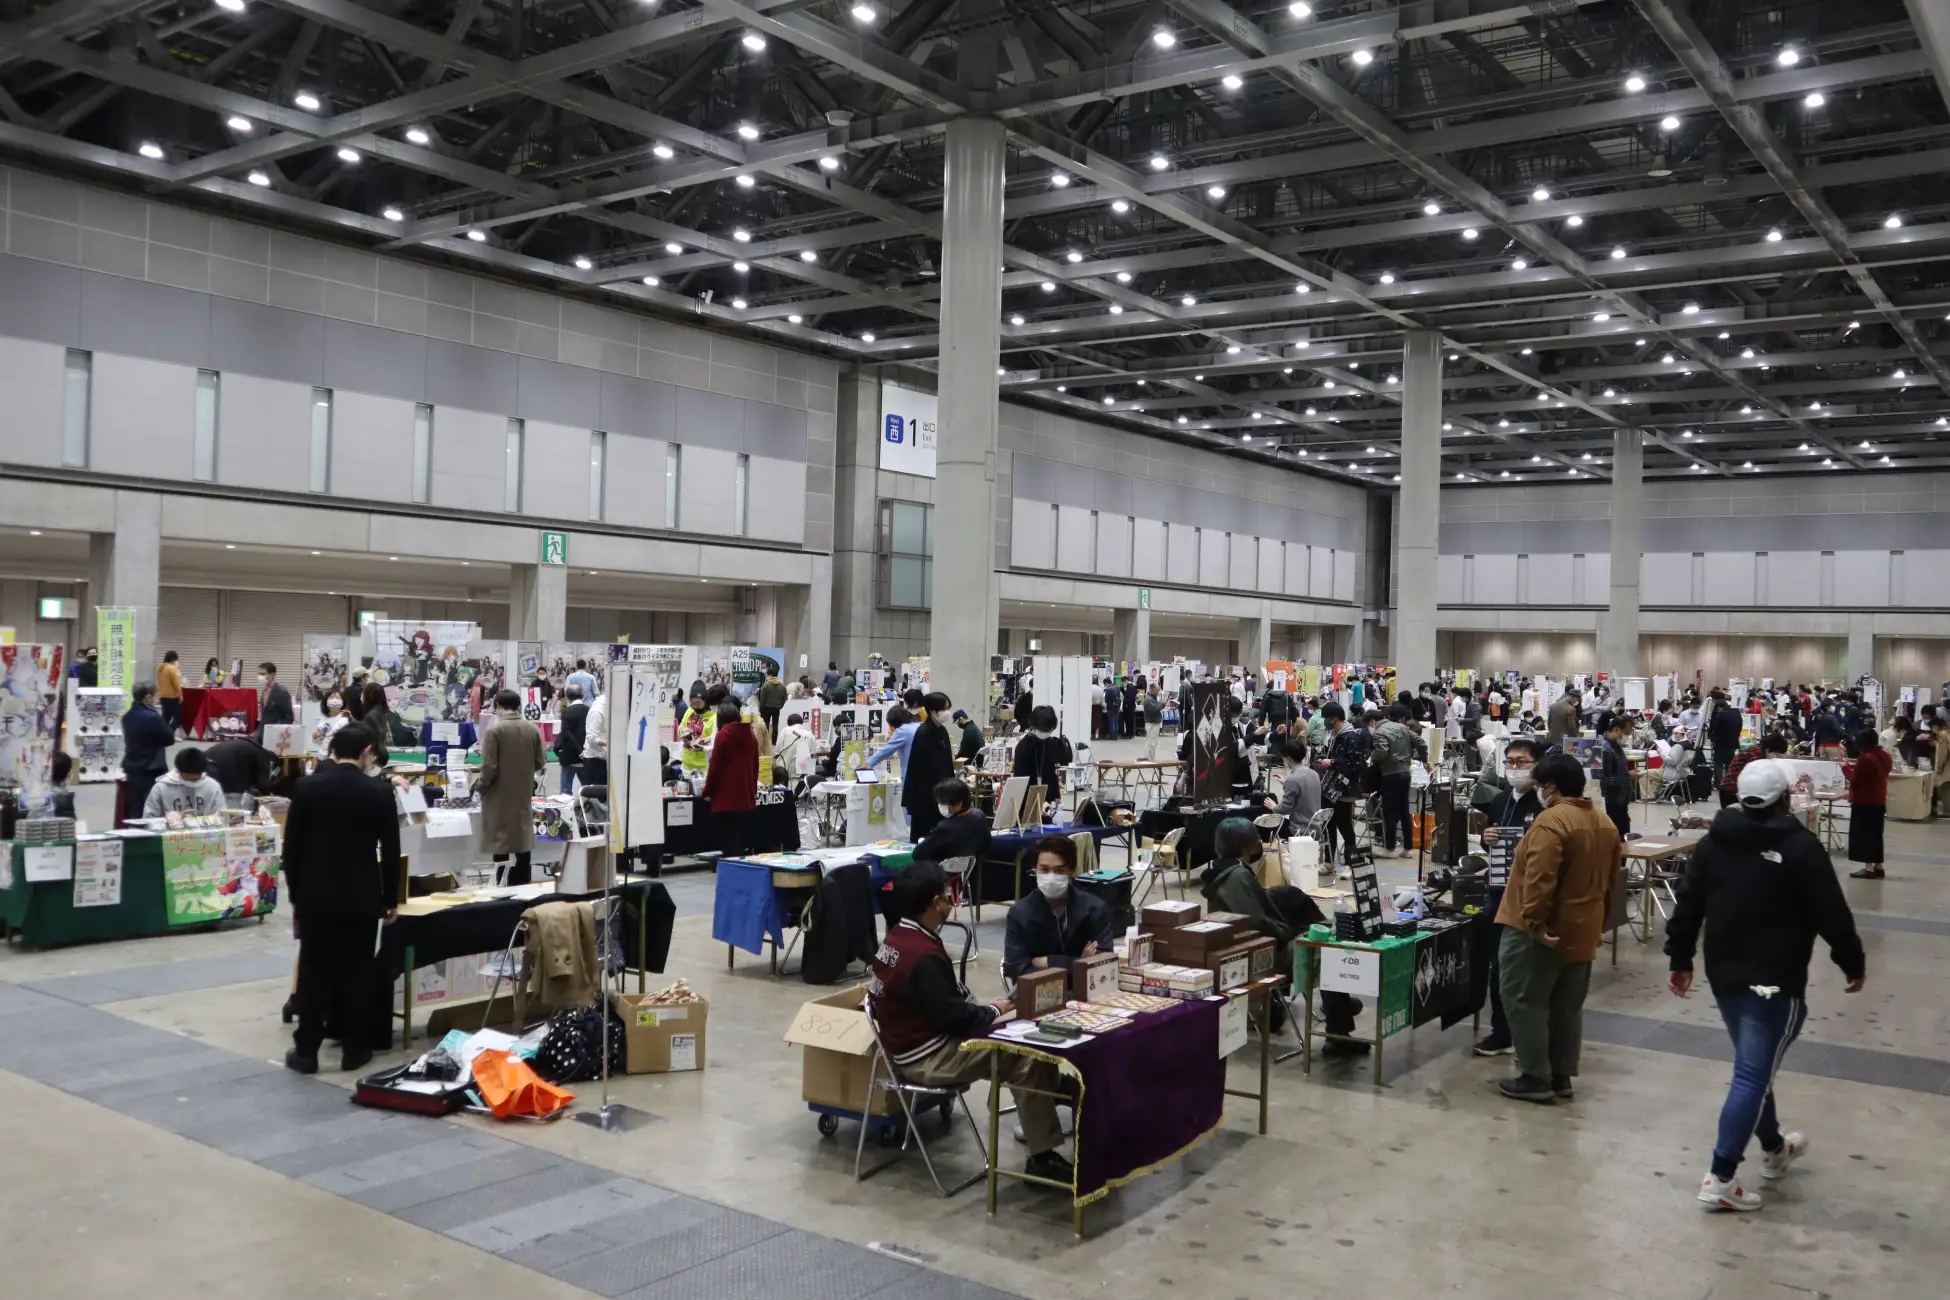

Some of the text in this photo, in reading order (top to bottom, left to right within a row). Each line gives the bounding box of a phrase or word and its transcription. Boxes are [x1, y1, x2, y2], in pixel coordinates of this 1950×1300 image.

[890, 425, 899, 440] 西
[910, 419, 916, 447] 1
[923, 421, 936, 432] 出口
[923, 433, 932, 442] Exit
[732, 650, 748, 659] A25
[636, 679, 656, 701] ウ イ
[173, 796, 205, 814] GAP
[1341, 957, 1360, 966] イ08
[800, 1014, 860, 1040] 861
